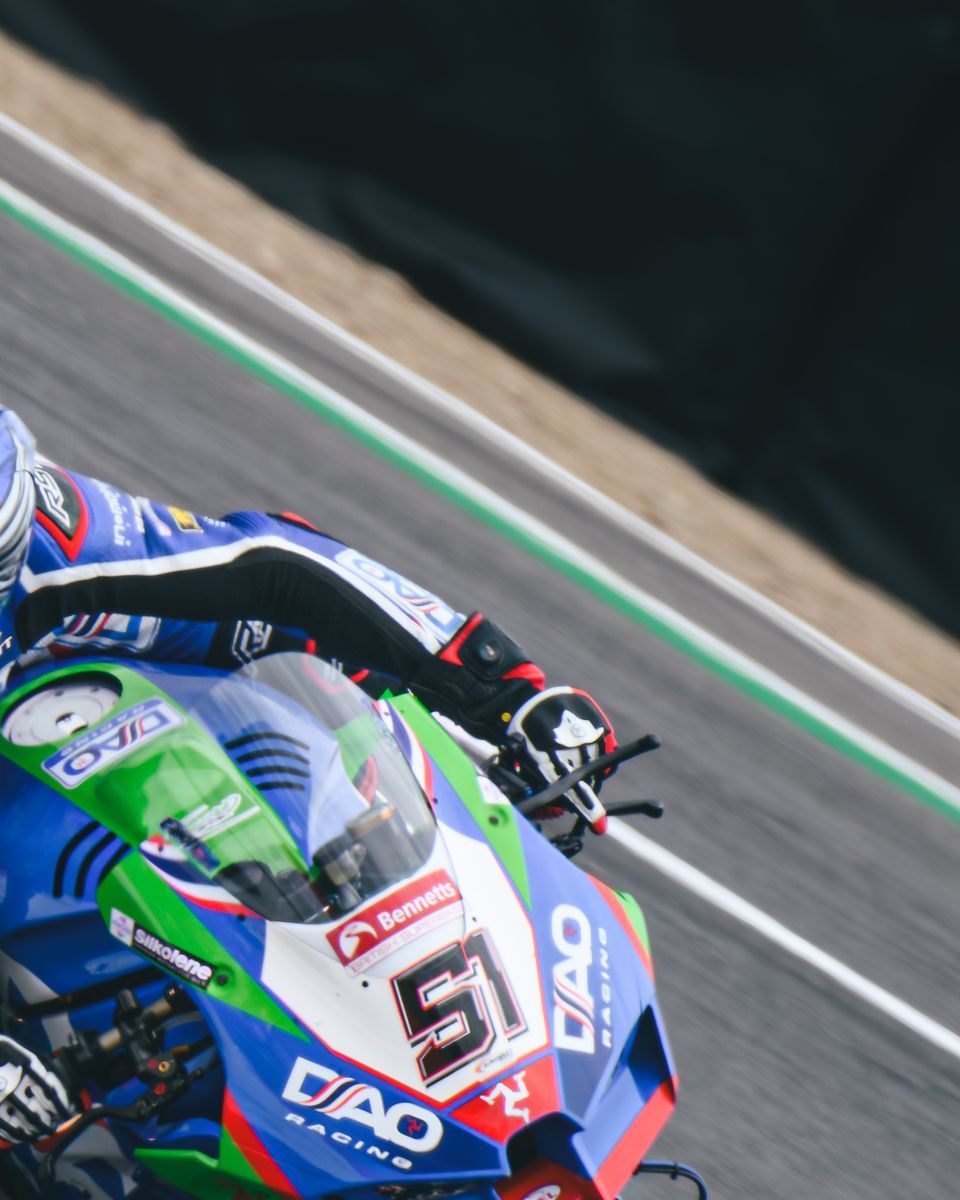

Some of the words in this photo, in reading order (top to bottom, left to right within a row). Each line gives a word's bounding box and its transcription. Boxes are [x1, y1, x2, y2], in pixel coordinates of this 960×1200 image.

[33, 464, 71, 529] RS
[376, 880, 456, 932] Bennetts
[133, 928, 213, 981] Silkolene
[551, 904, 596, 1055] DAO
[597, 927, 612, 1048] RACING
[388, 925, 529, 1089] 51
[282, 1056, 444, 1153] DAO
[284, 1112, 413, 1171] RACING
